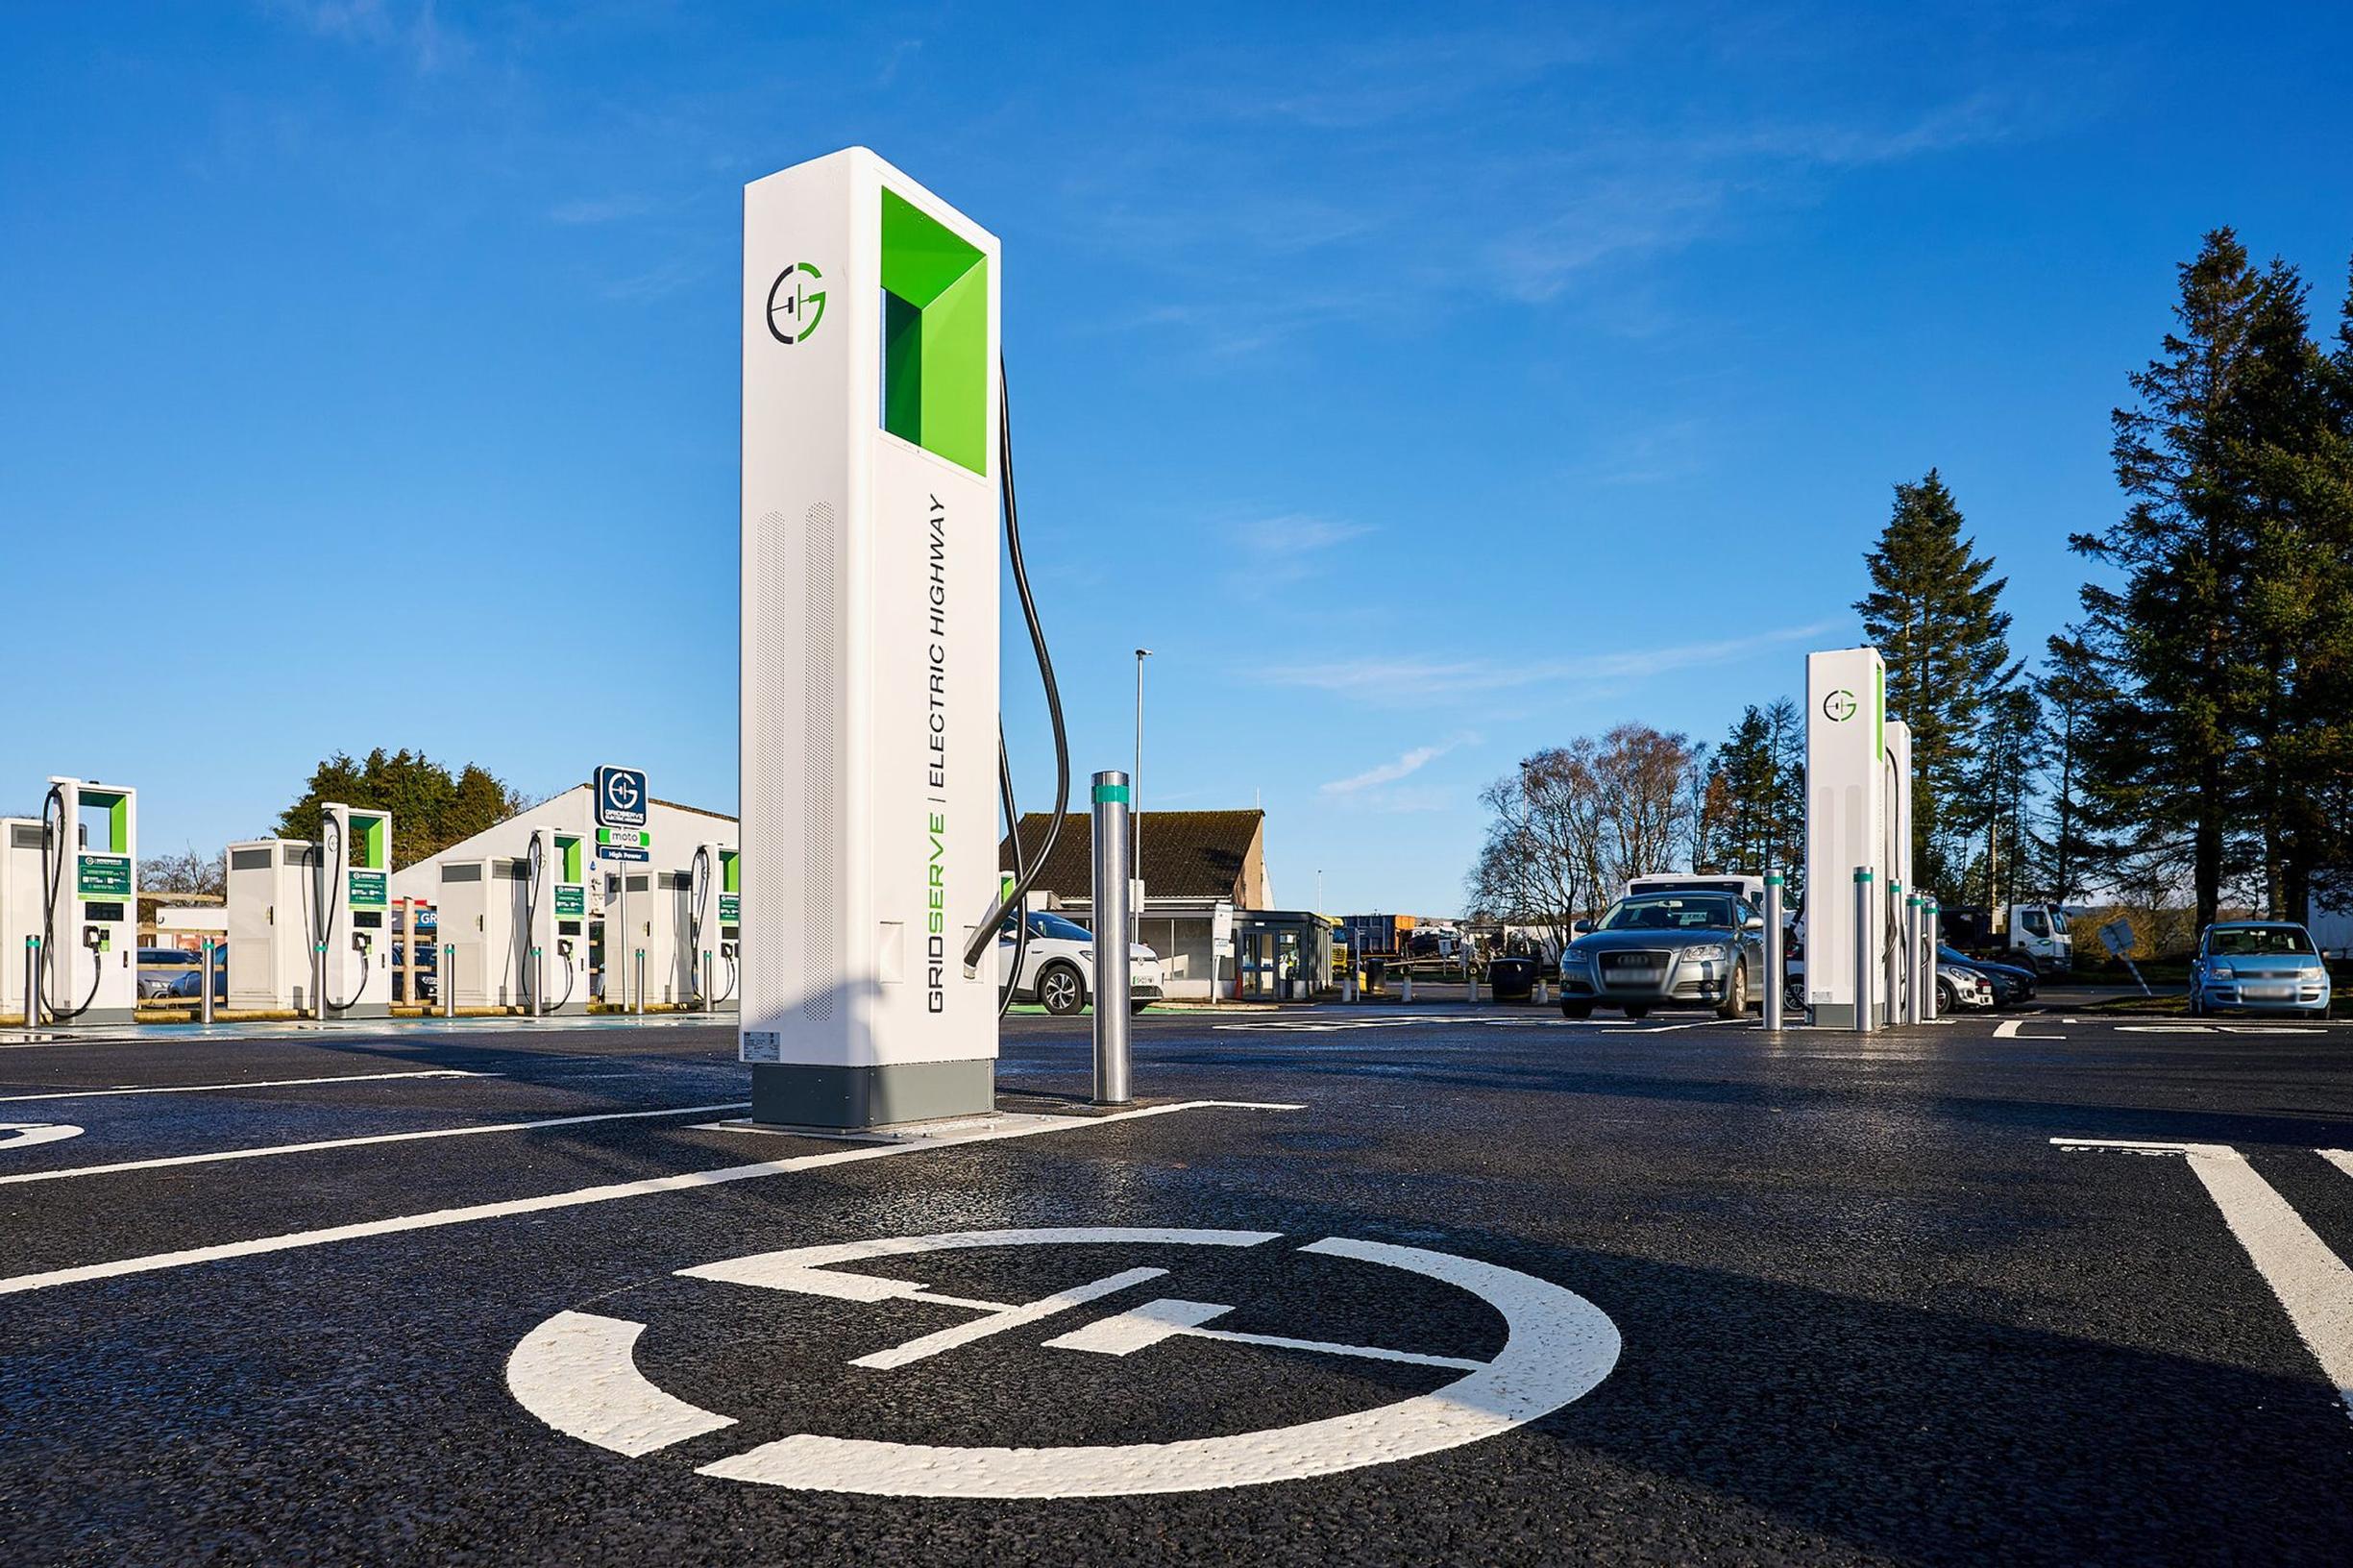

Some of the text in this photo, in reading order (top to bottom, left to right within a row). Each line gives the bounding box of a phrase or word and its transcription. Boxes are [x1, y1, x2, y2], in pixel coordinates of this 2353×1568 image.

[928, 493, 945, 1014] GRIDSERVE ELECTRIC HIGHWAY
[612, 832, 638, 843] moto
[608, 851, 623, 860] High
